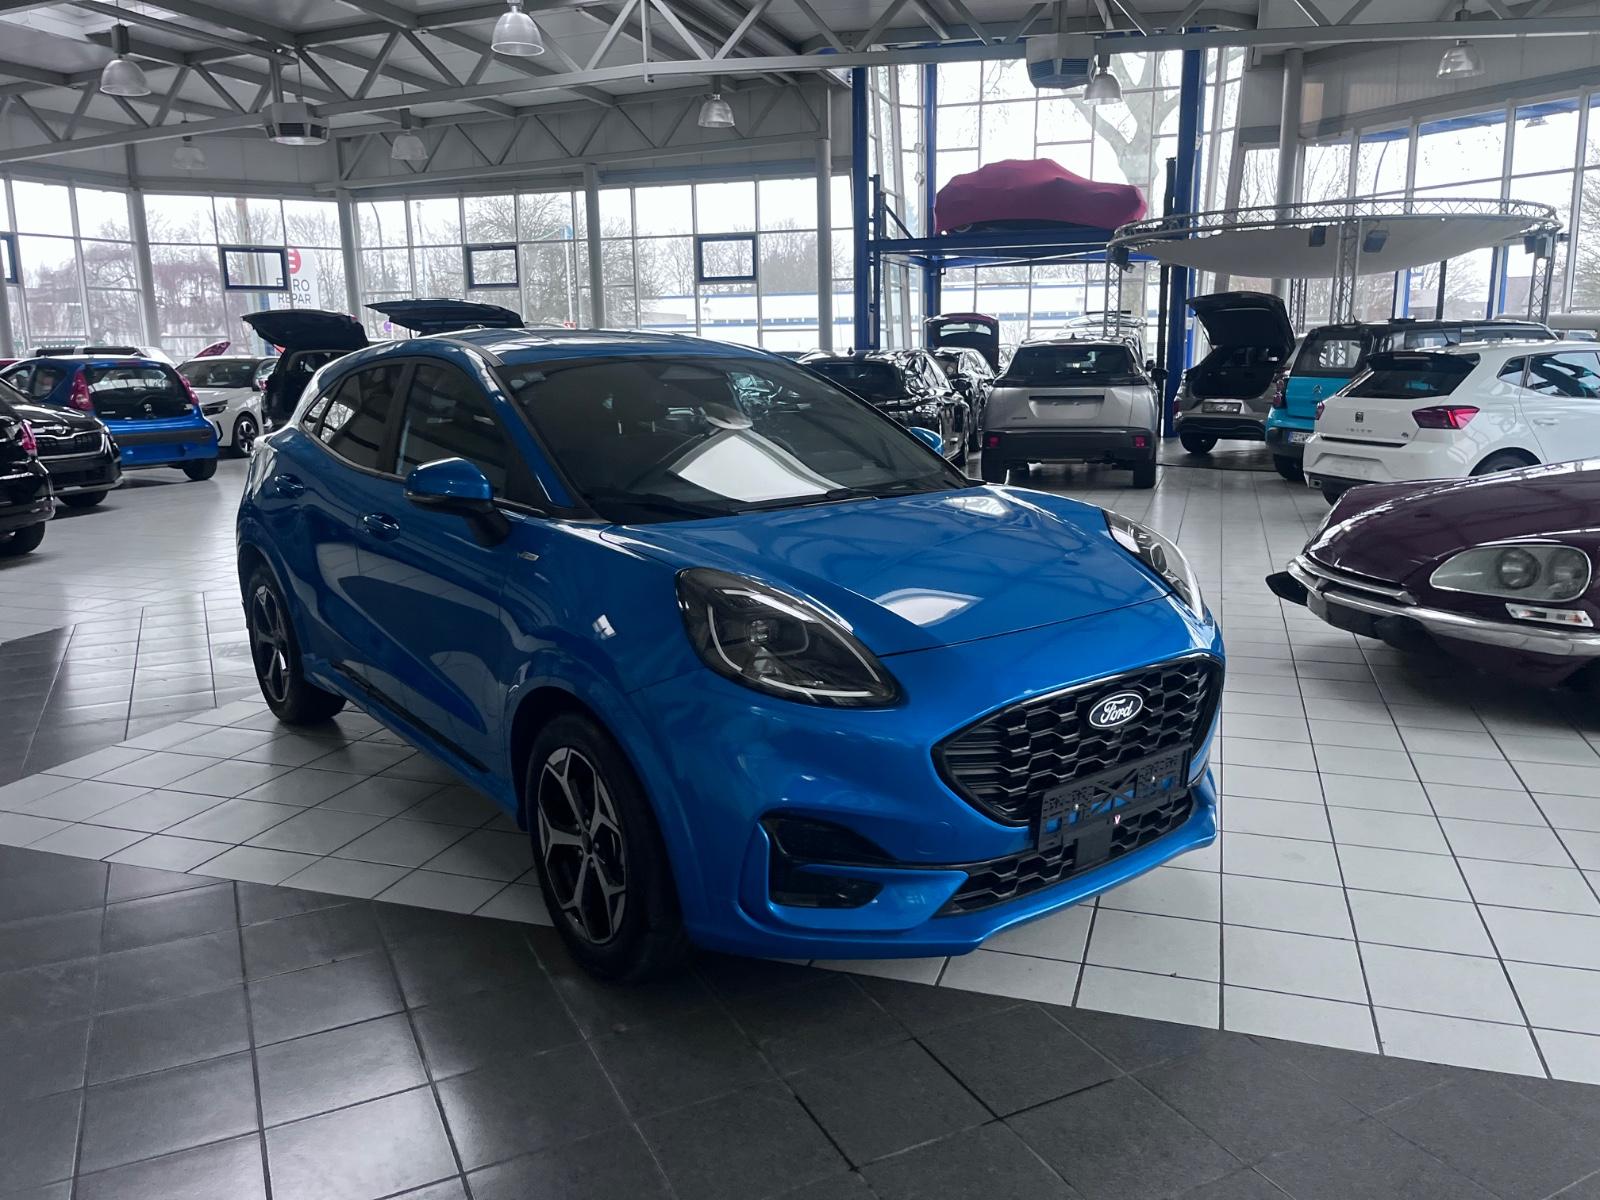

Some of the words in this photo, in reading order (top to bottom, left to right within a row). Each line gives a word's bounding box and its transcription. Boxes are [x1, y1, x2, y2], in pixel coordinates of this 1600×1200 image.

[276, 277, 310, 291] ERO
[278, 292, 311, 304] REPAR
[1100, 698, 1133, 723] Ford
